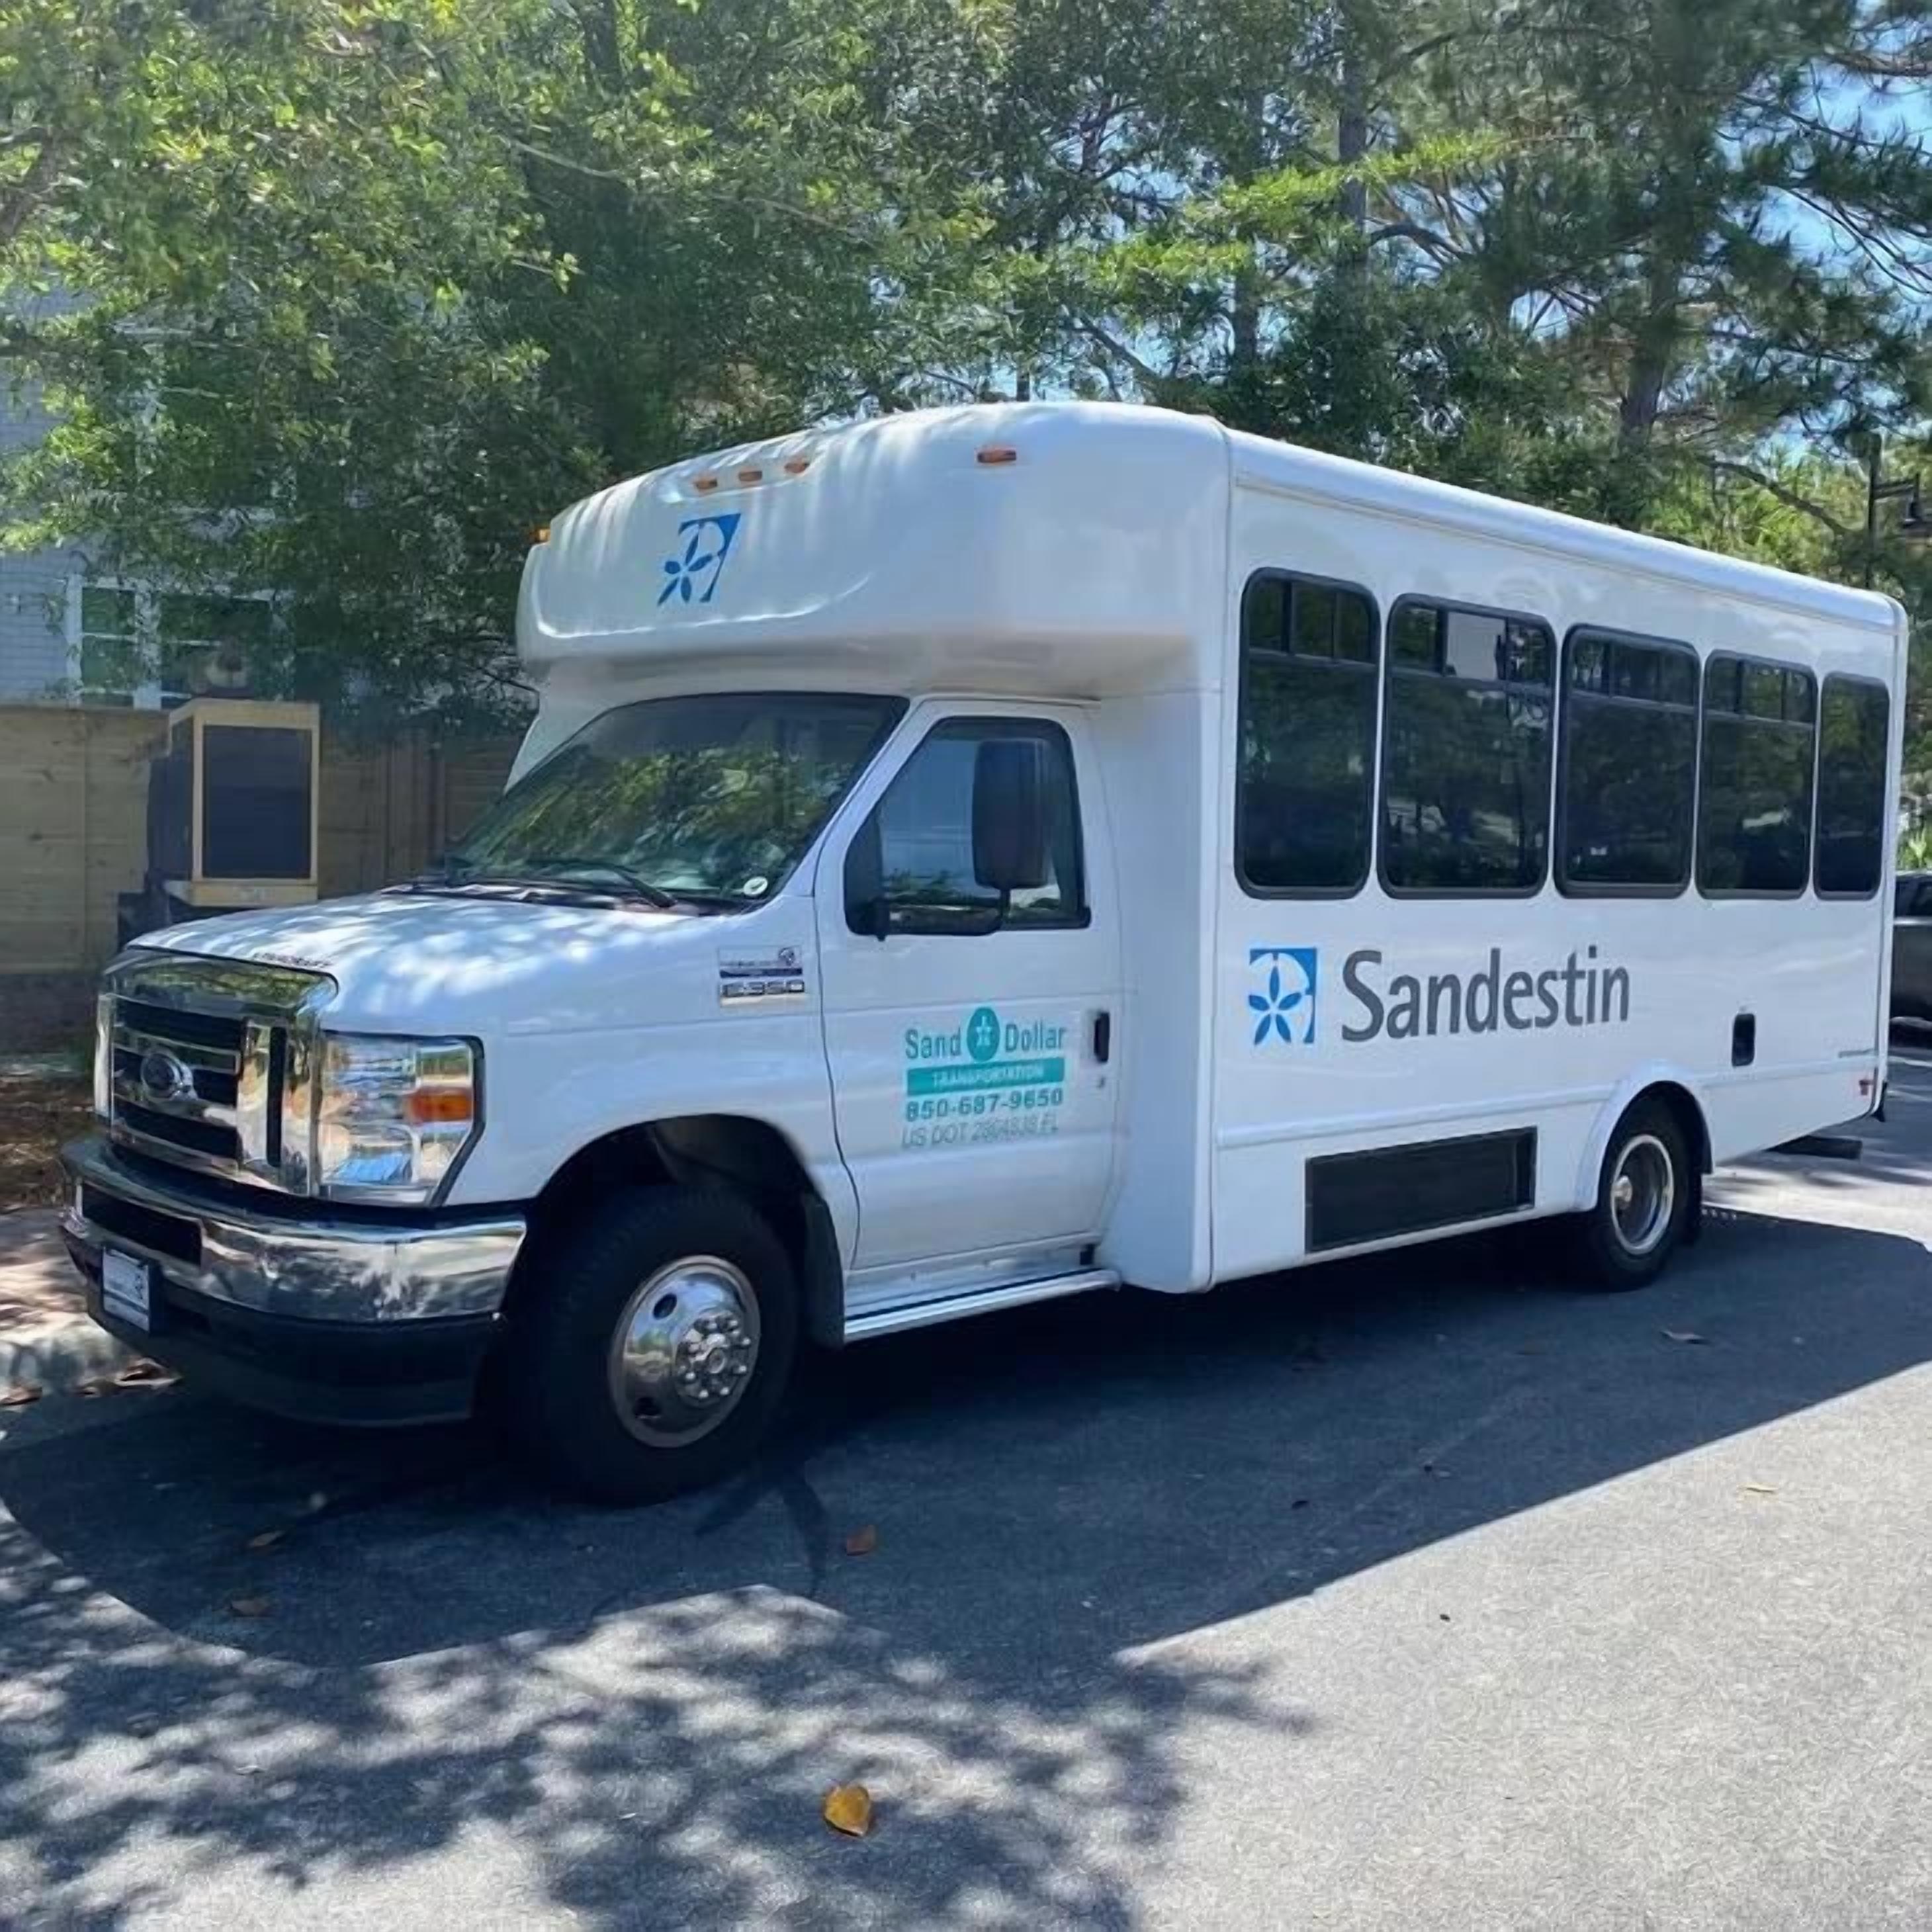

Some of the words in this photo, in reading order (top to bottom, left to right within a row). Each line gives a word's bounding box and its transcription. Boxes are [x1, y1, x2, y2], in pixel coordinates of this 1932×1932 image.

[1341, 945, 1630, 1043] Sandestin
[904, 1026, 962, 1059] Sand
[1004, 1021, 1067, 1053] Dollar
[901, 1126, 926, 1149] US
[931, 1123, 968, 1145] DOT
